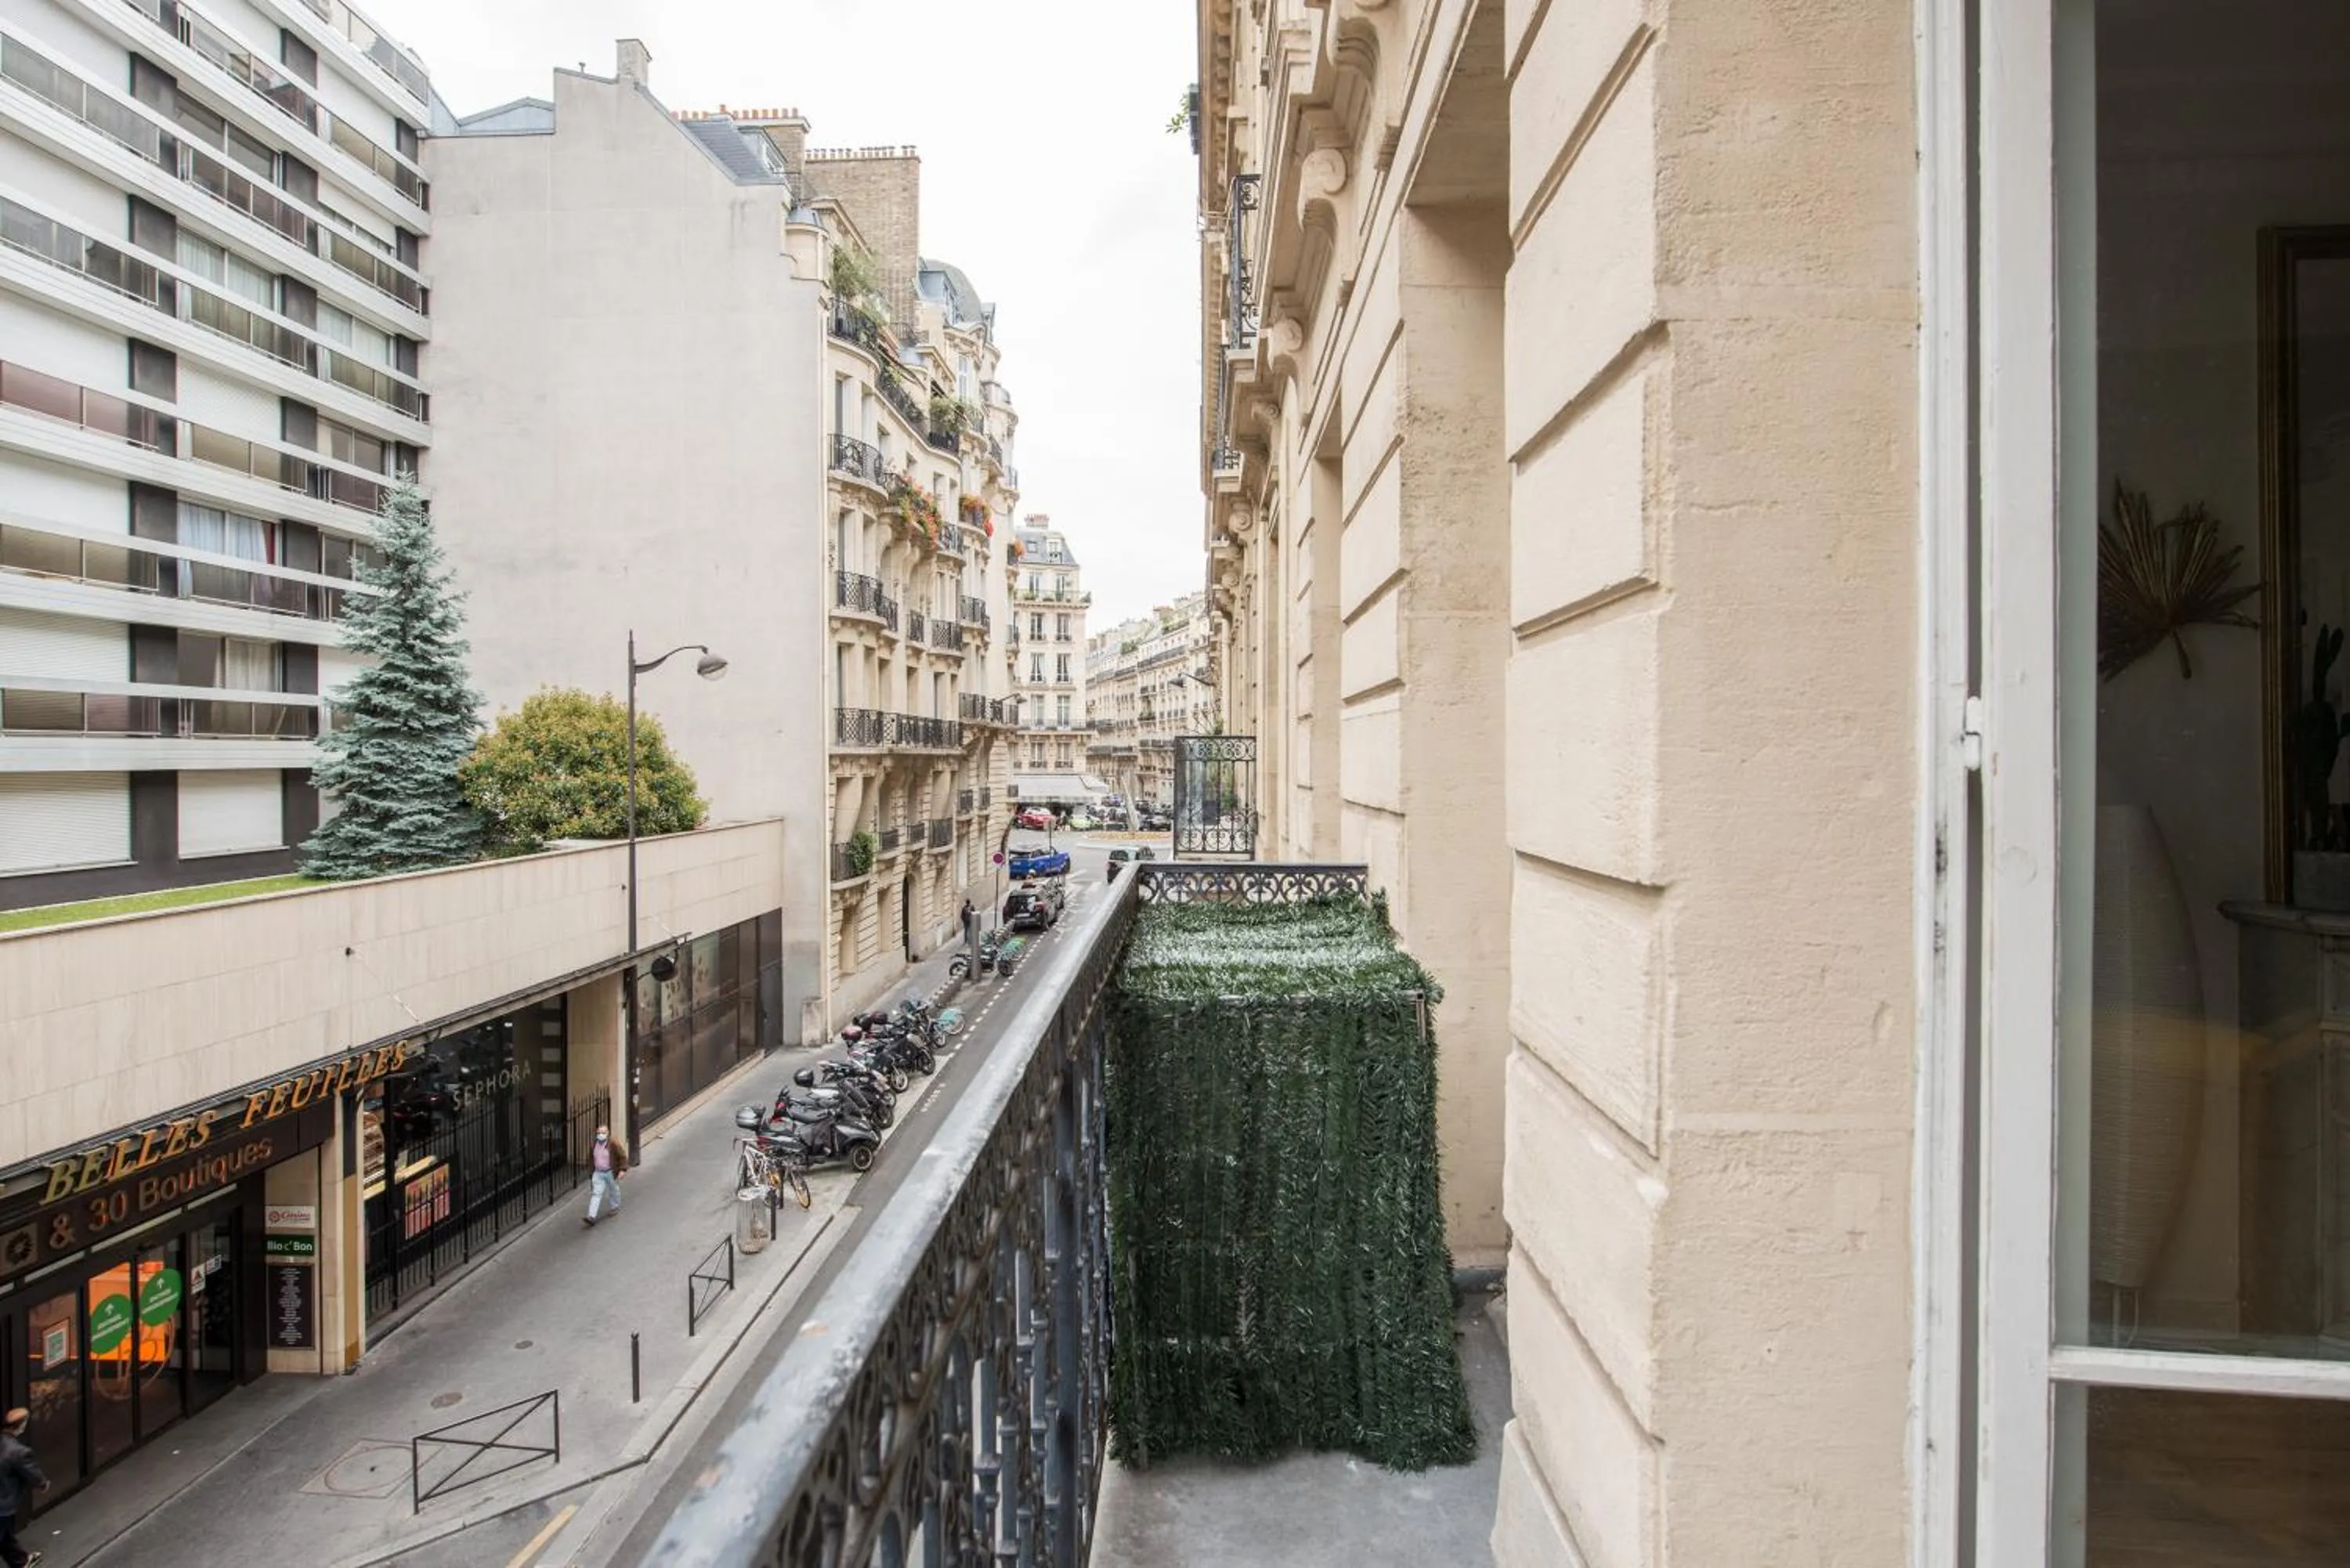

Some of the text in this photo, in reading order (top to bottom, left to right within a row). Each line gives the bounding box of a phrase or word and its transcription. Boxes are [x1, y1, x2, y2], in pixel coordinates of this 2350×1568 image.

[40, 1039, 408, 1206] BELLES FEUILLES
[452, 1059, 531, 1111] SEPHORA
[49, 1137, 273, 1250] & 30 Boutiques
